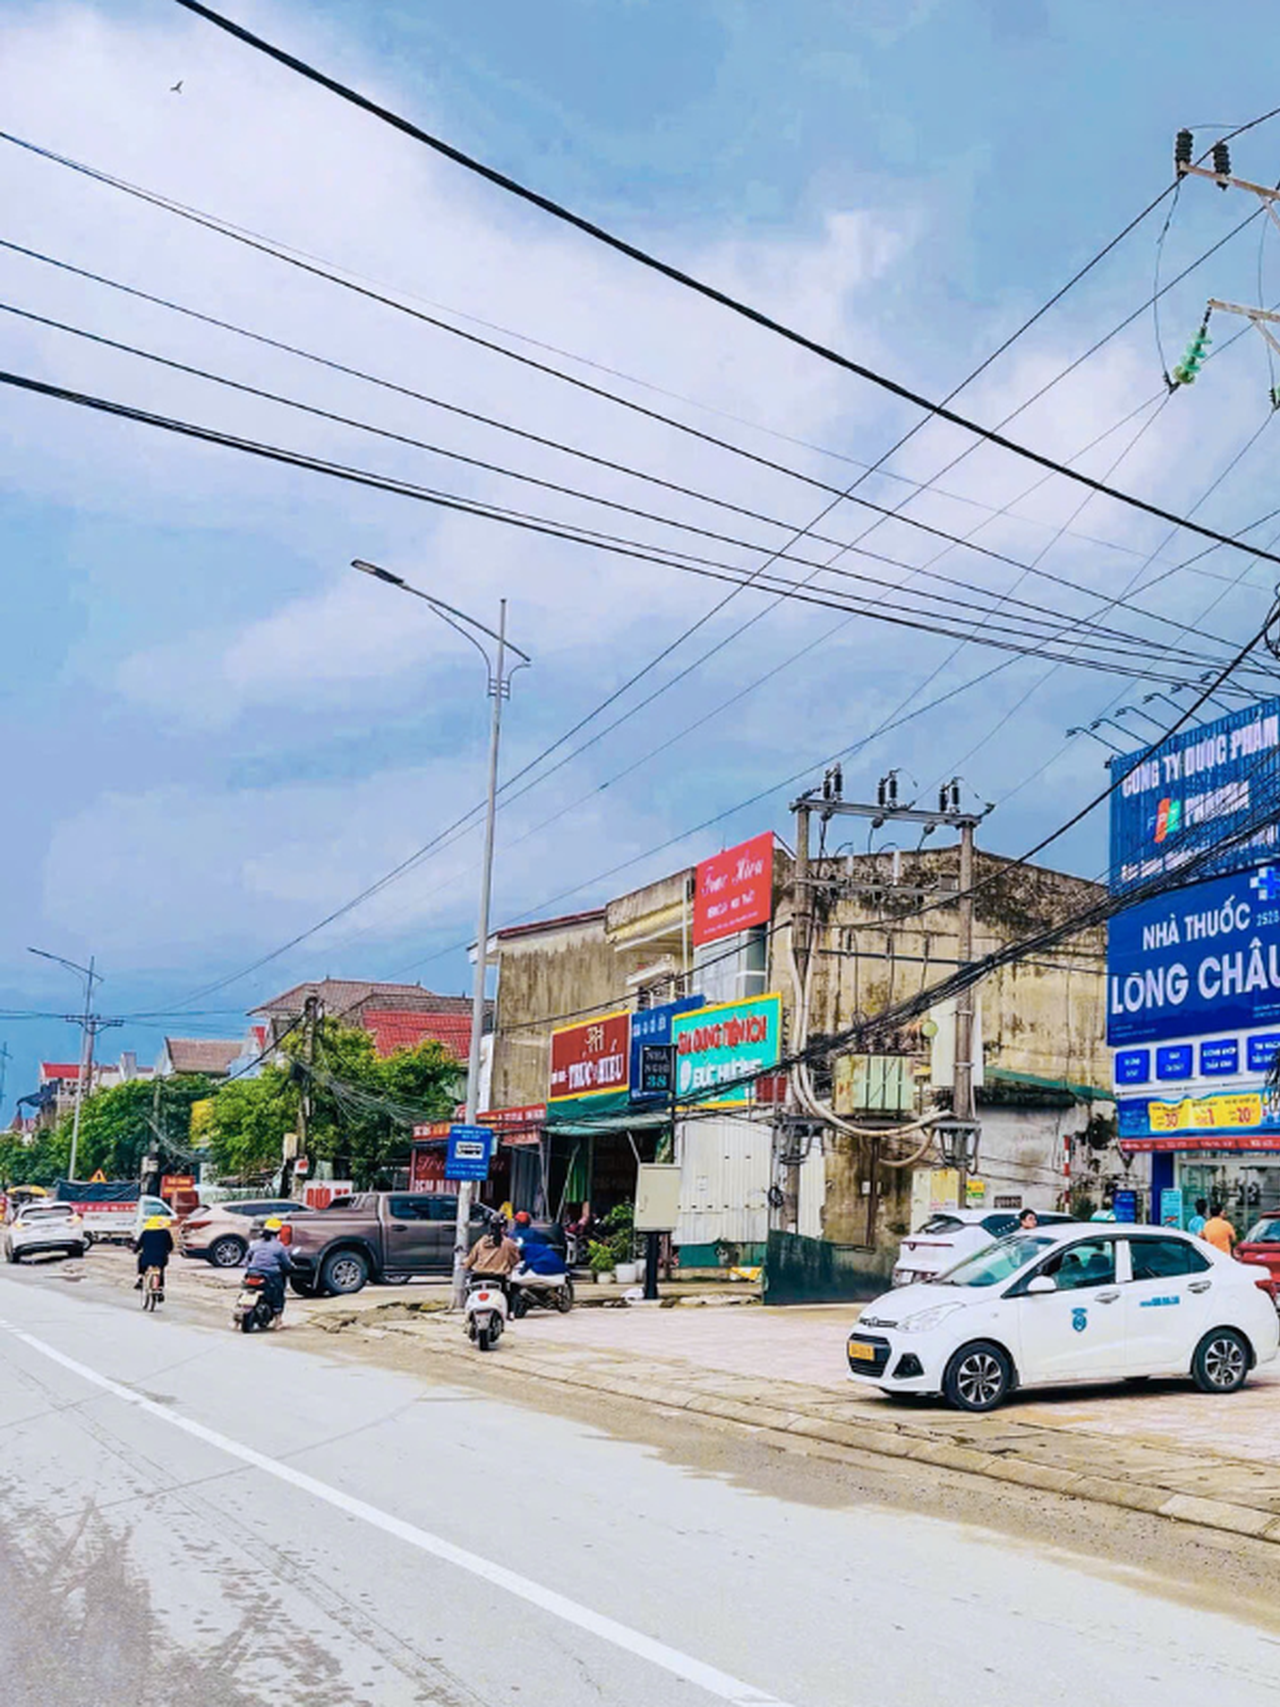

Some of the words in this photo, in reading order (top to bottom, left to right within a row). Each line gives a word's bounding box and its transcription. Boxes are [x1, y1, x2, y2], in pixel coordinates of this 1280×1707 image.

[1164, 751, 1183, 783] TY
[1142, 914, 1180, 951] NHÀ
[1184, 895, 1251, 942] THUỐC
[1110, 963, 1190, 1015] LONG
